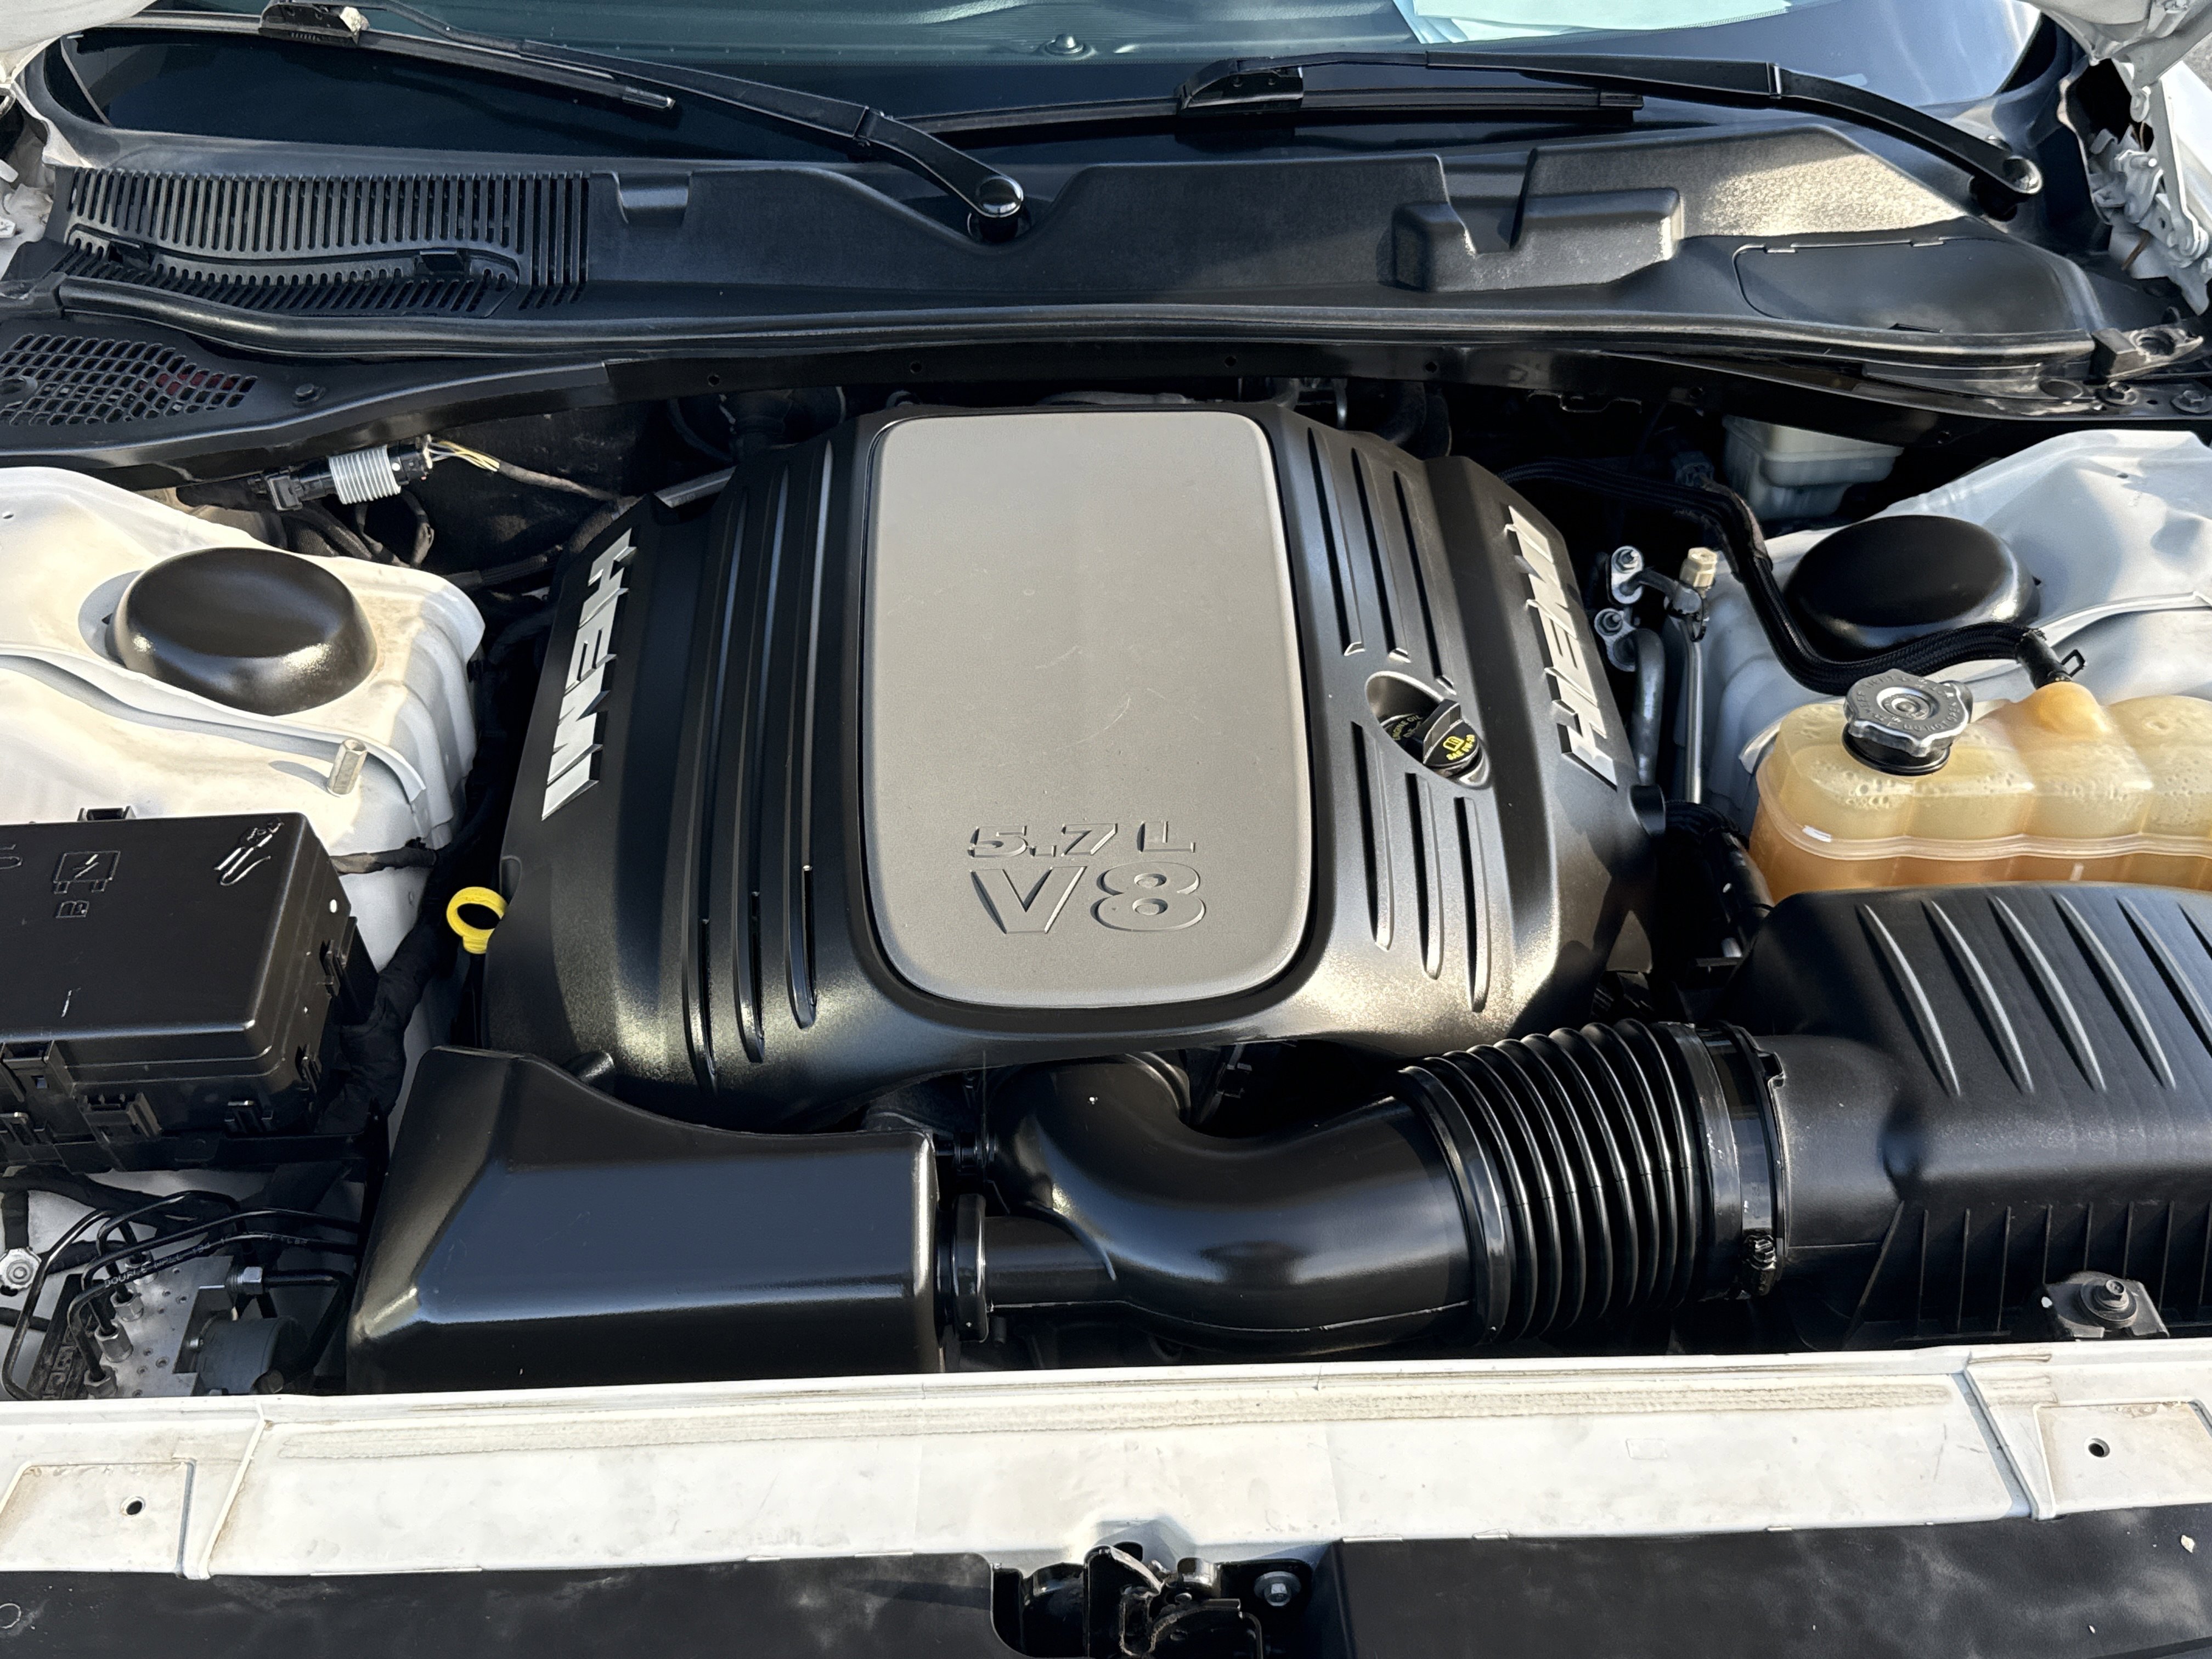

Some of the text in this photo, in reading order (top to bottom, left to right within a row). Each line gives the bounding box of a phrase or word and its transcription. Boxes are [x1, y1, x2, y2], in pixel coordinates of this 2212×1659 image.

[1506, 505, 1617, 792] HEMI
[541, 528, 634, 821] HEMI
[1392, 720, 1409, 740] ENGINE
[1925, 720, 1950, 731] NOT
[1446, 750, 1464, 760] SAE
[969, 861, 1206, 934] V8
